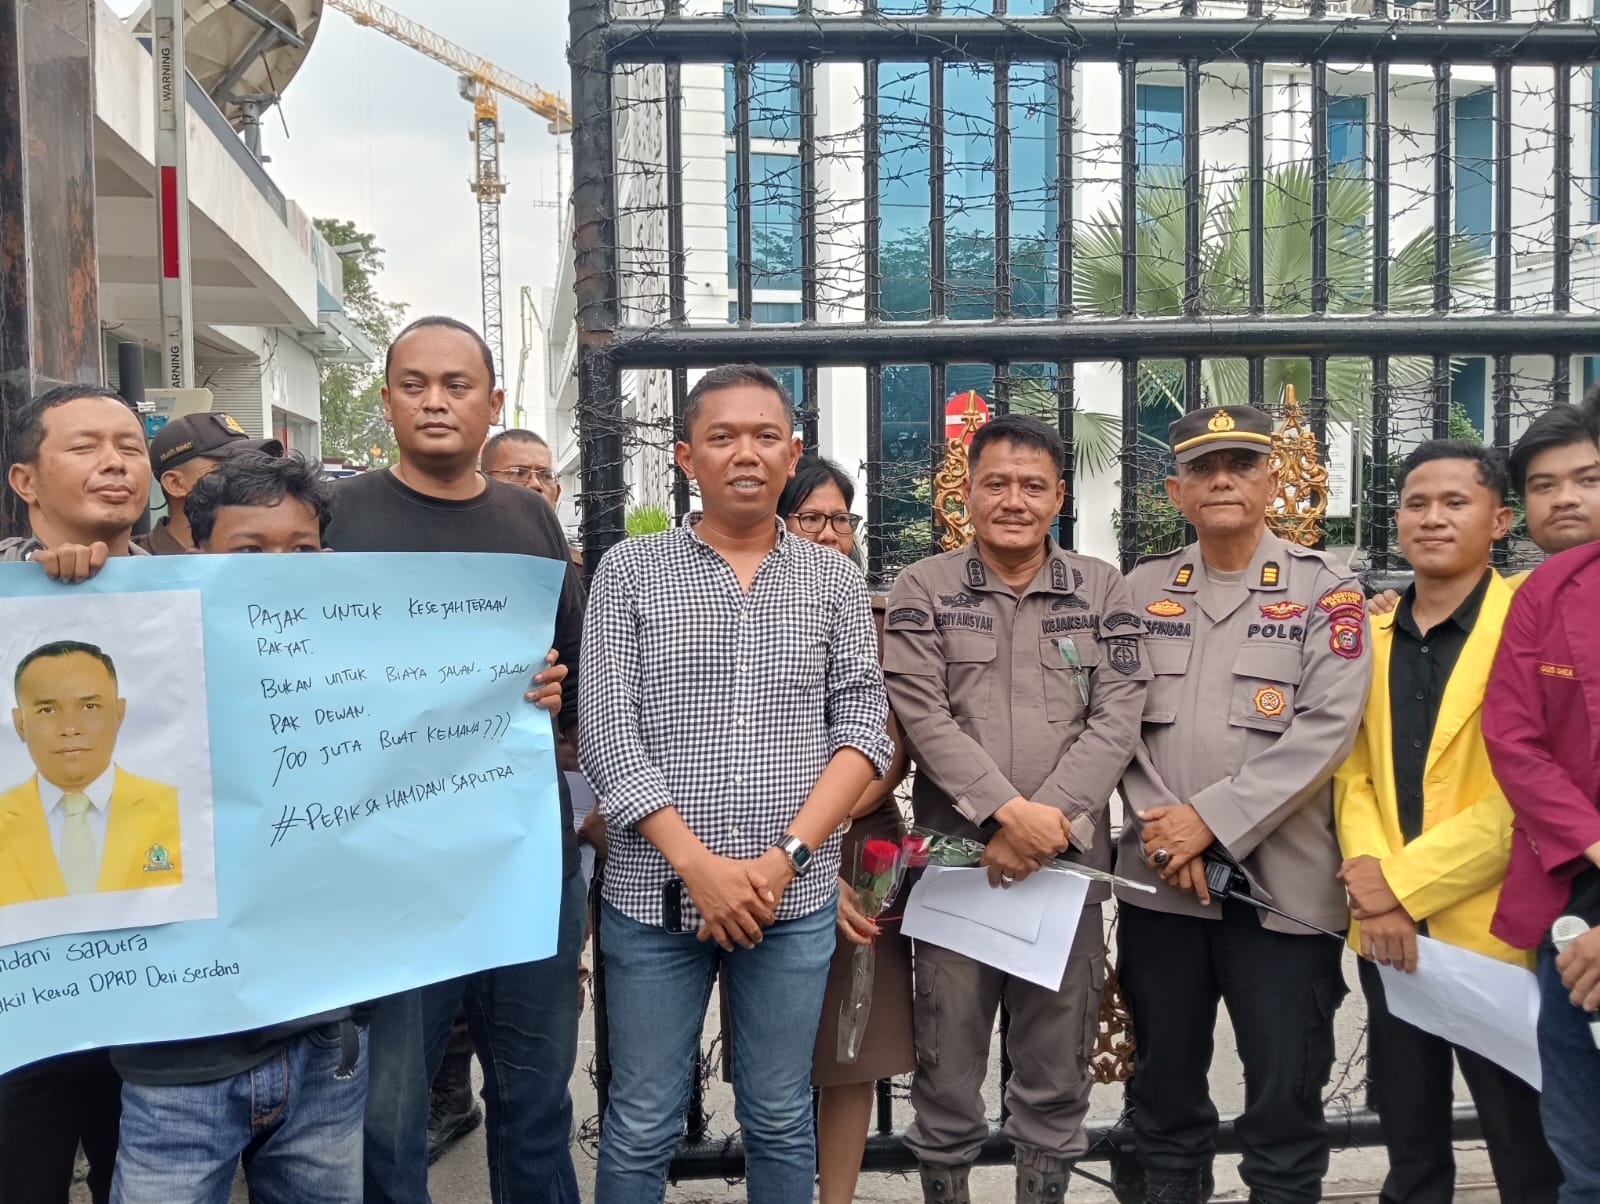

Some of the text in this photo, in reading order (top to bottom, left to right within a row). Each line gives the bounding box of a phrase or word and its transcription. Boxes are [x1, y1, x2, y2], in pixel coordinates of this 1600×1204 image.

[161, 47, 172, 102] WARNING
[170, 345, 181, 389] ARNING
[248, 604, 308, 633] PAJAK
[323, 602, 383, 621] UNTUK
[1142, 620, 1190, 637] SFINDRA
[1247, 624, 1303, 641] POLR
[261, 677, 312, 699] BUKAN
[386, 665, 427, 683] BIAYA
[270, 713, 301, 735] PAK
[272, 746, 307, 787] 700
[319, 740, 362, 765] JUTA
[380, 730, 418, 751] BUAT
[0, 991, 26, 1014] kil
[89, 969, 137, 992] DPRD
